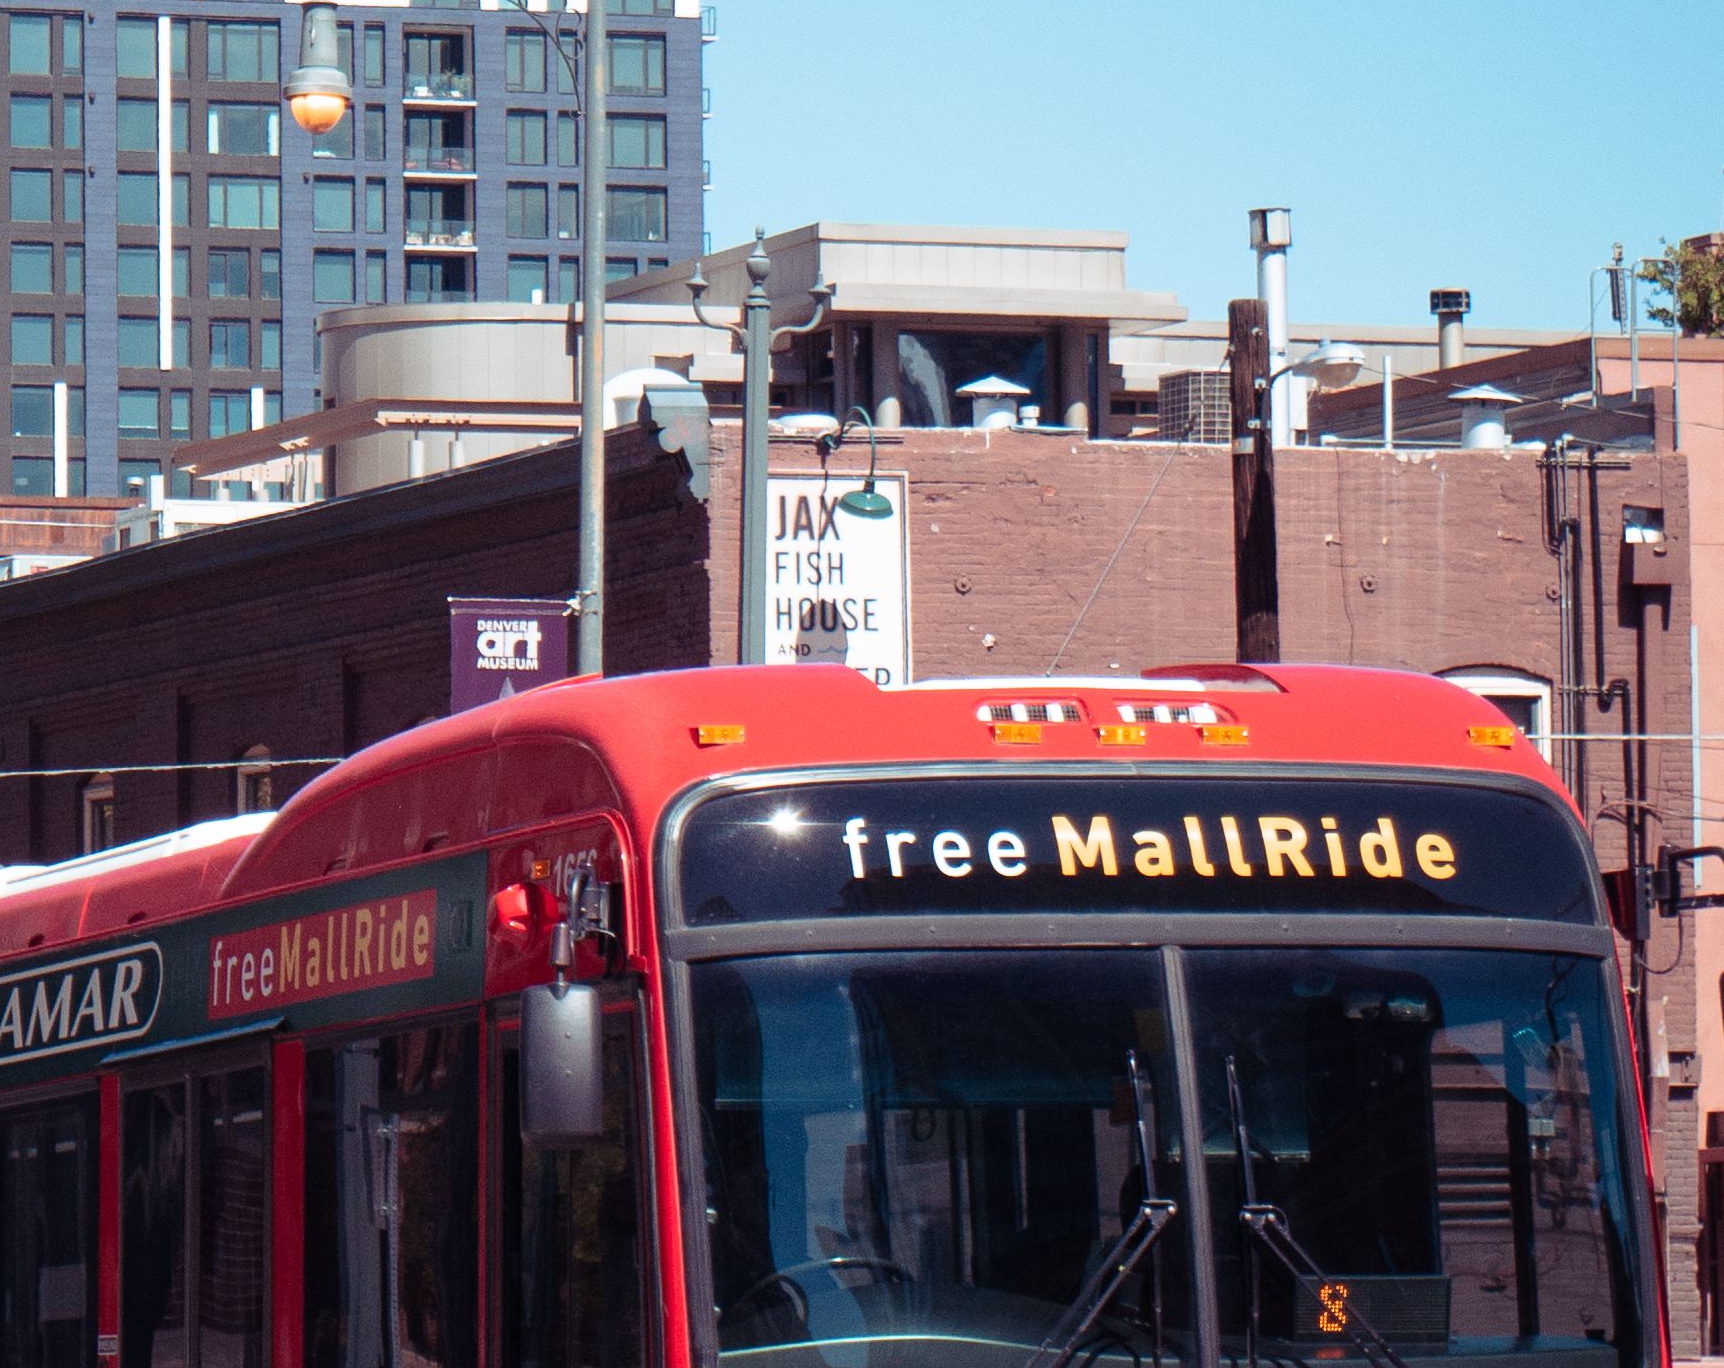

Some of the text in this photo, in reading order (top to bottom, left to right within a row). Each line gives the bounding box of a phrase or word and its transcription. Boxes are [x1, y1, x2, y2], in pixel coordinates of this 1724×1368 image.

[775, 495, 841, 541] JAX
[775, 552, 844, 585] FISH
[477, 620, 530, 632] DENVER
[776, 598, 878, 632] HOUSE
[477, 657, 539, 670] MUSEUM
[778, 643, 812, 657] AND
[1320, 1284, 1347, 1332] 8
